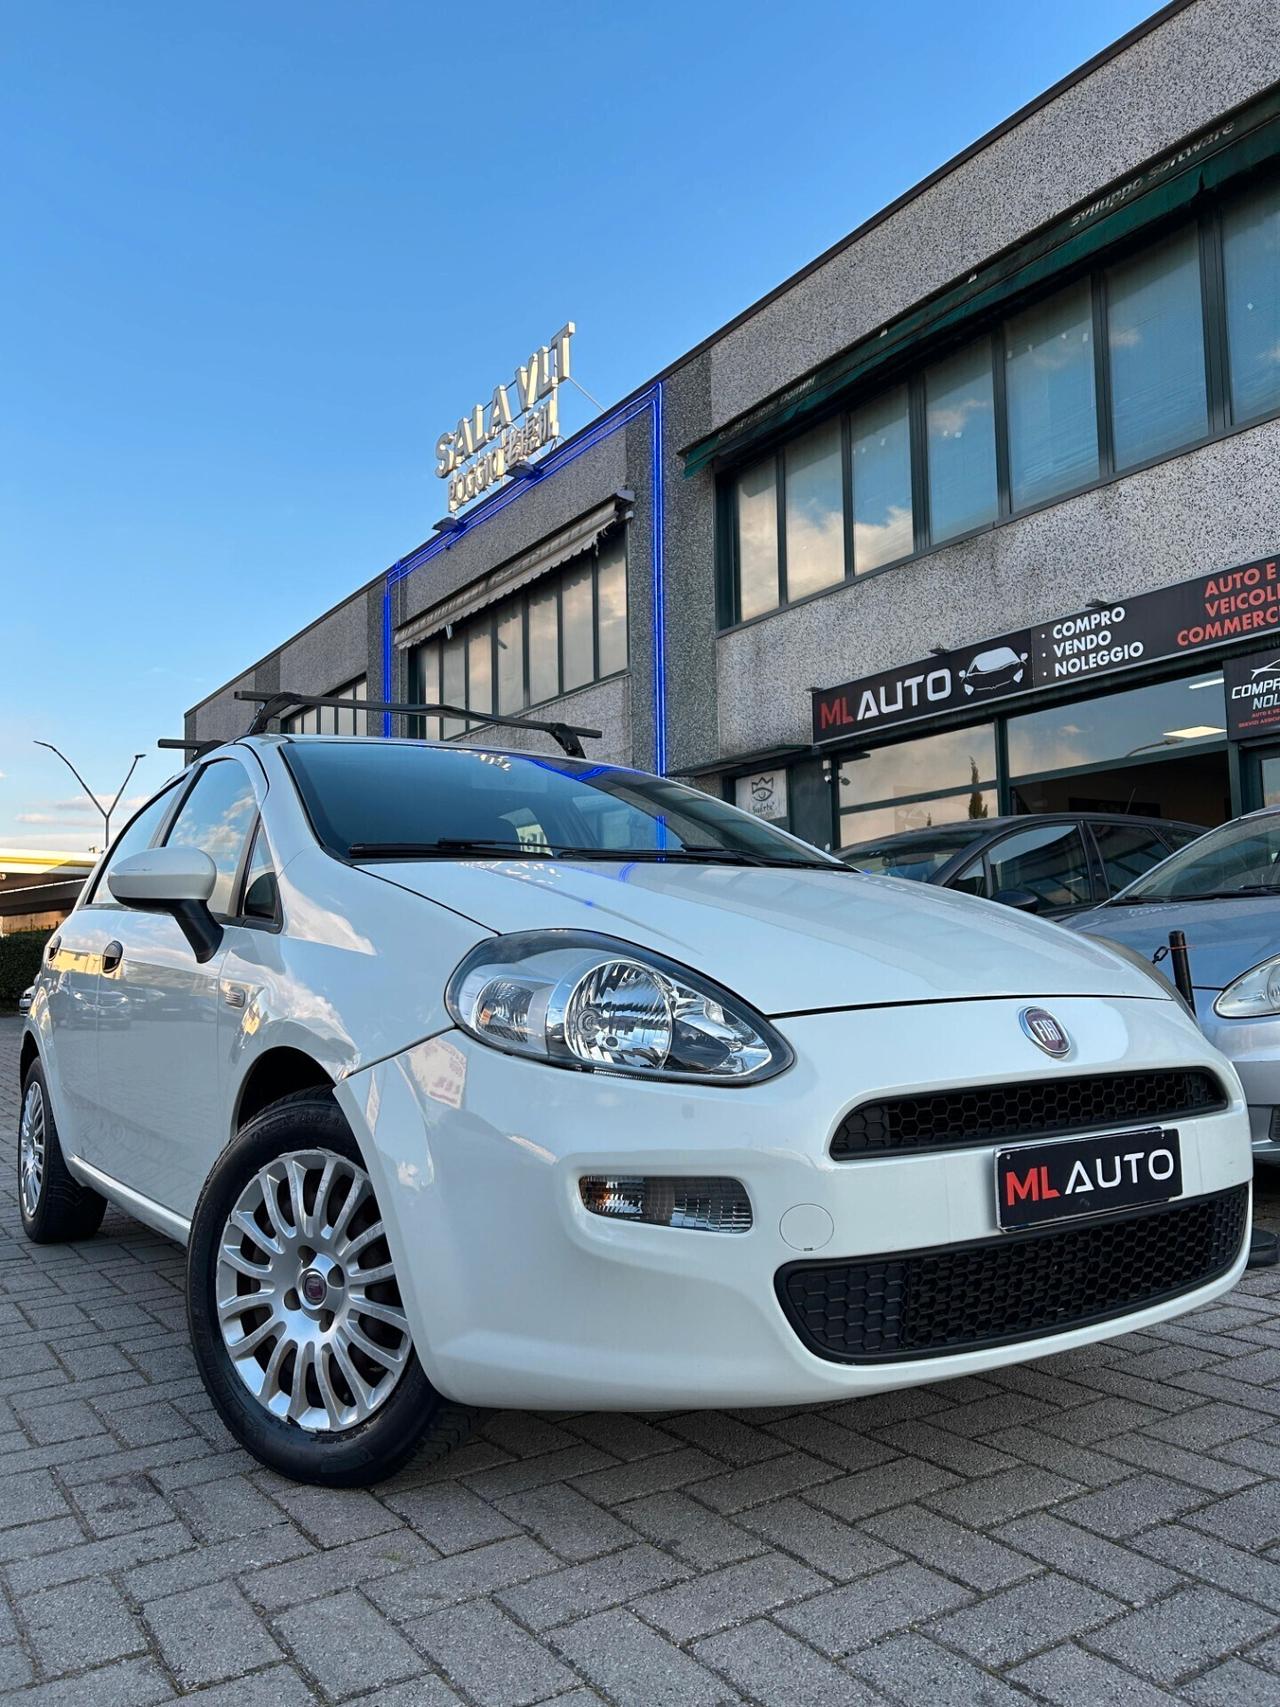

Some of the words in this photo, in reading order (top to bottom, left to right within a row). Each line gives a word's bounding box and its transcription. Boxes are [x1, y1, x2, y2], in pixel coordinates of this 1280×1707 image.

[435, 384, 512, 478] SALA
[514, 321, 576, 413] VLT
[1205, 568, 1260, 597] AUTO
[1266, 562, 1277, 579] E
[1053, 606, 1125, 639] COMPRO
[1177, 605, 1280, 646] COMMERC
[1053, 630, 1112, 658] VENDO
[1054, 641, 1144, 677] NOLEGGIO
[820, 697, 853, 729] ML
[857, 668, 952, 721] AUTO
[1006, 1166, 1061, 1206] ML
[1065, 1149, 1174, 1195] AUTO
